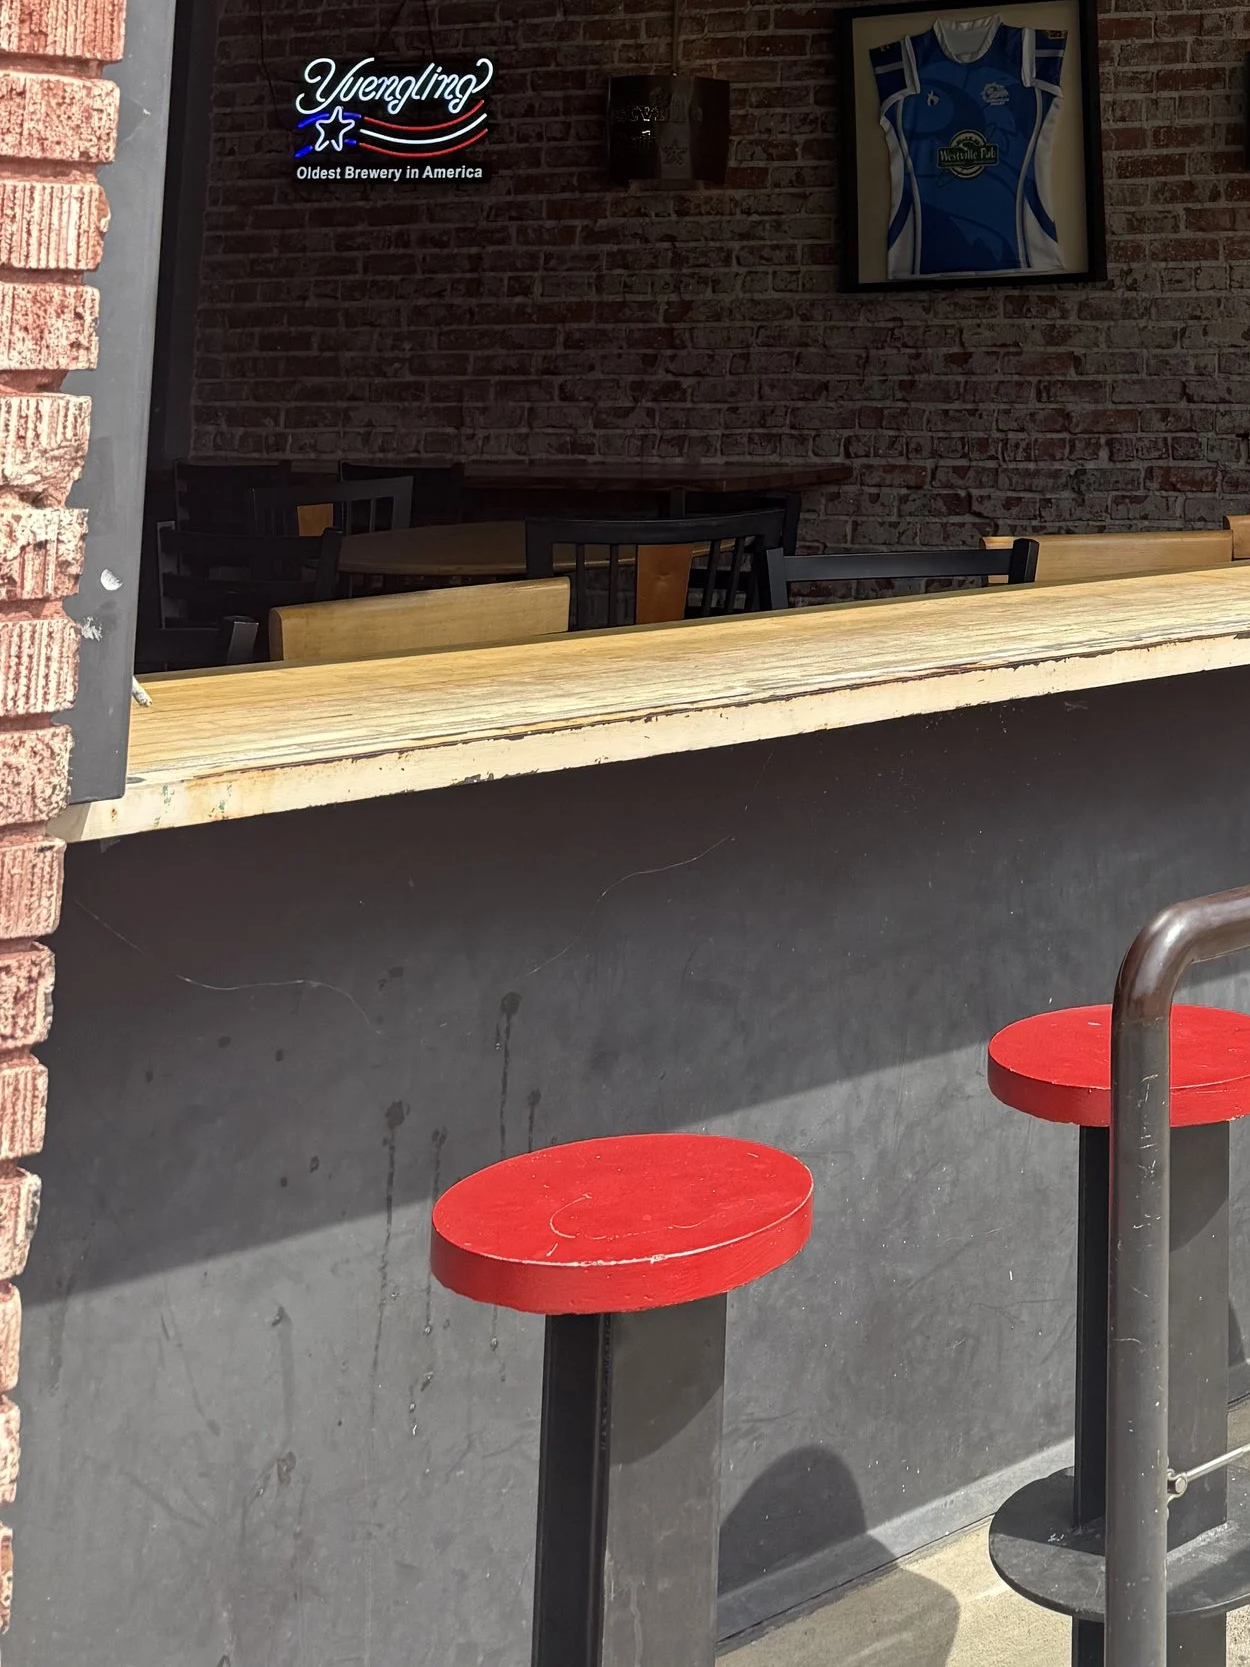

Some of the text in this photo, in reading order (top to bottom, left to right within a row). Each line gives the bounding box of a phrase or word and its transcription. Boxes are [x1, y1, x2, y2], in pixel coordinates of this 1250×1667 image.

[296, 57, 494, 114] Yuengling
[940, 146, 996, 162] Westville Pub
[296, 165, 483, 182] Oldest Brewery in America
